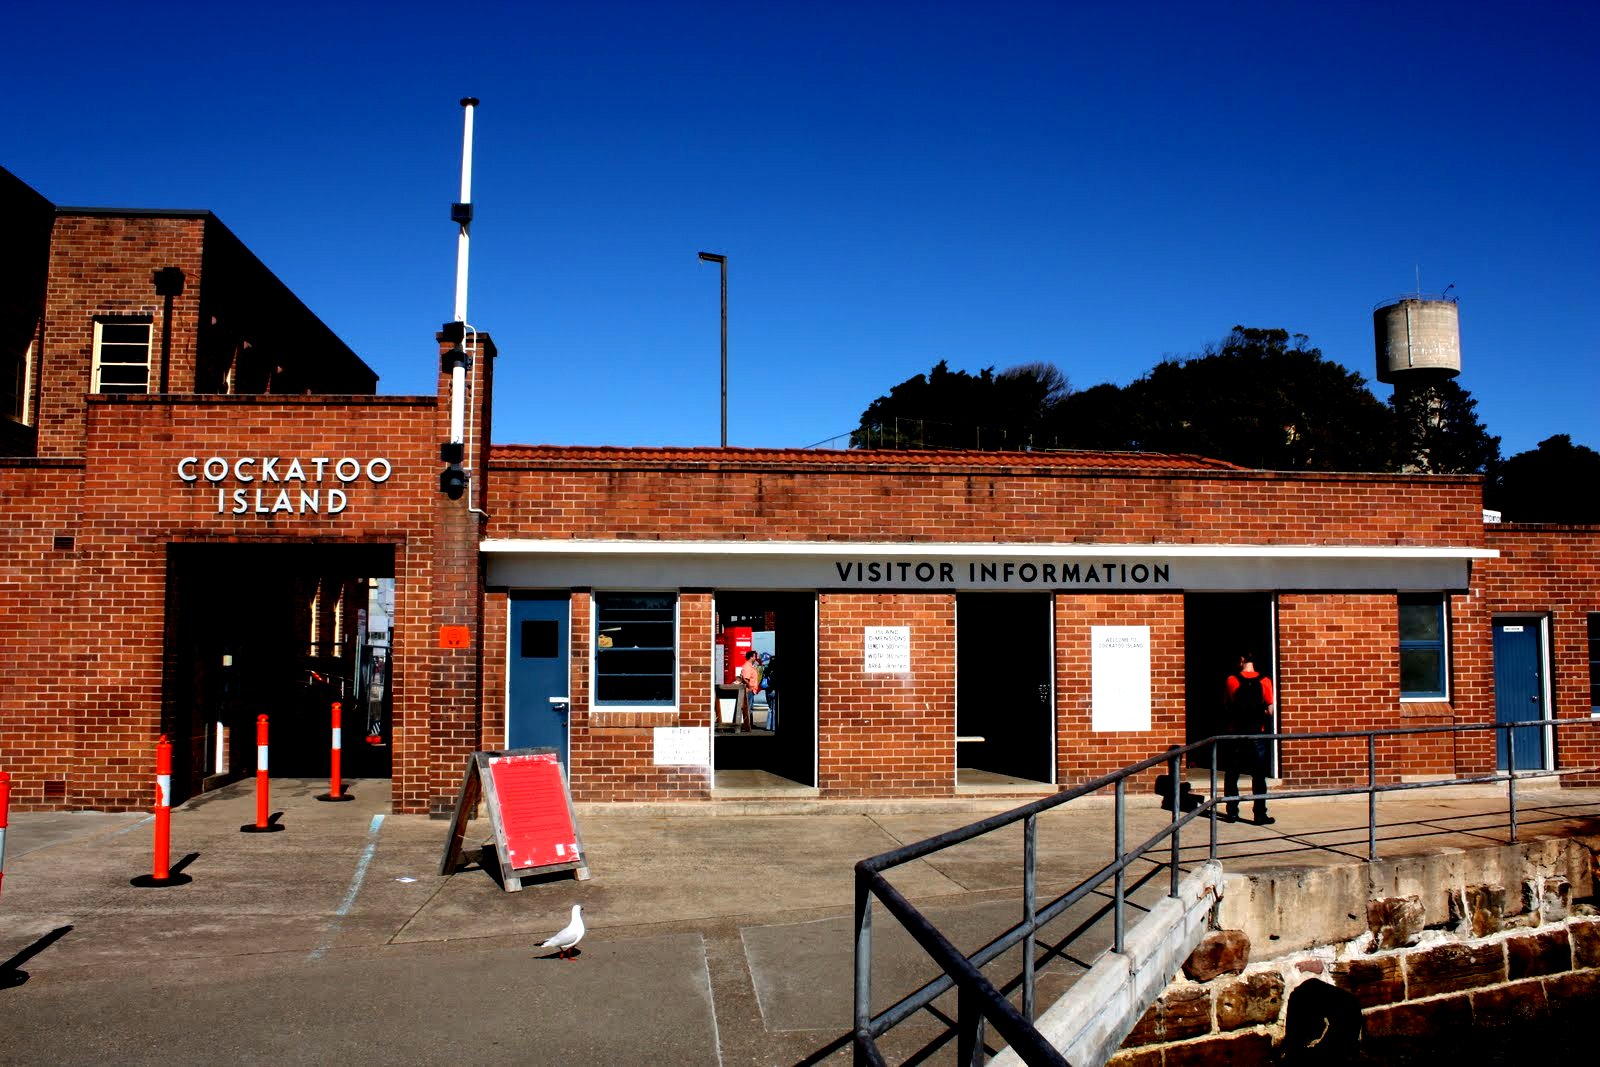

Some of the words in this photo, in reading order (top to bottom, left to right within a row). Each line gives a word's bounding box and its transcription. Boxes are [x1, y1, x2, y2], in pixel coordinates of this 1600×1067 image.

[177, 457, 392, 483] COCKATOO
[218, 488, 347, 514] ISLAND
[836, 562, 955, 582] VISITOR
[969, 563, 1170, 583] INFORMATION
